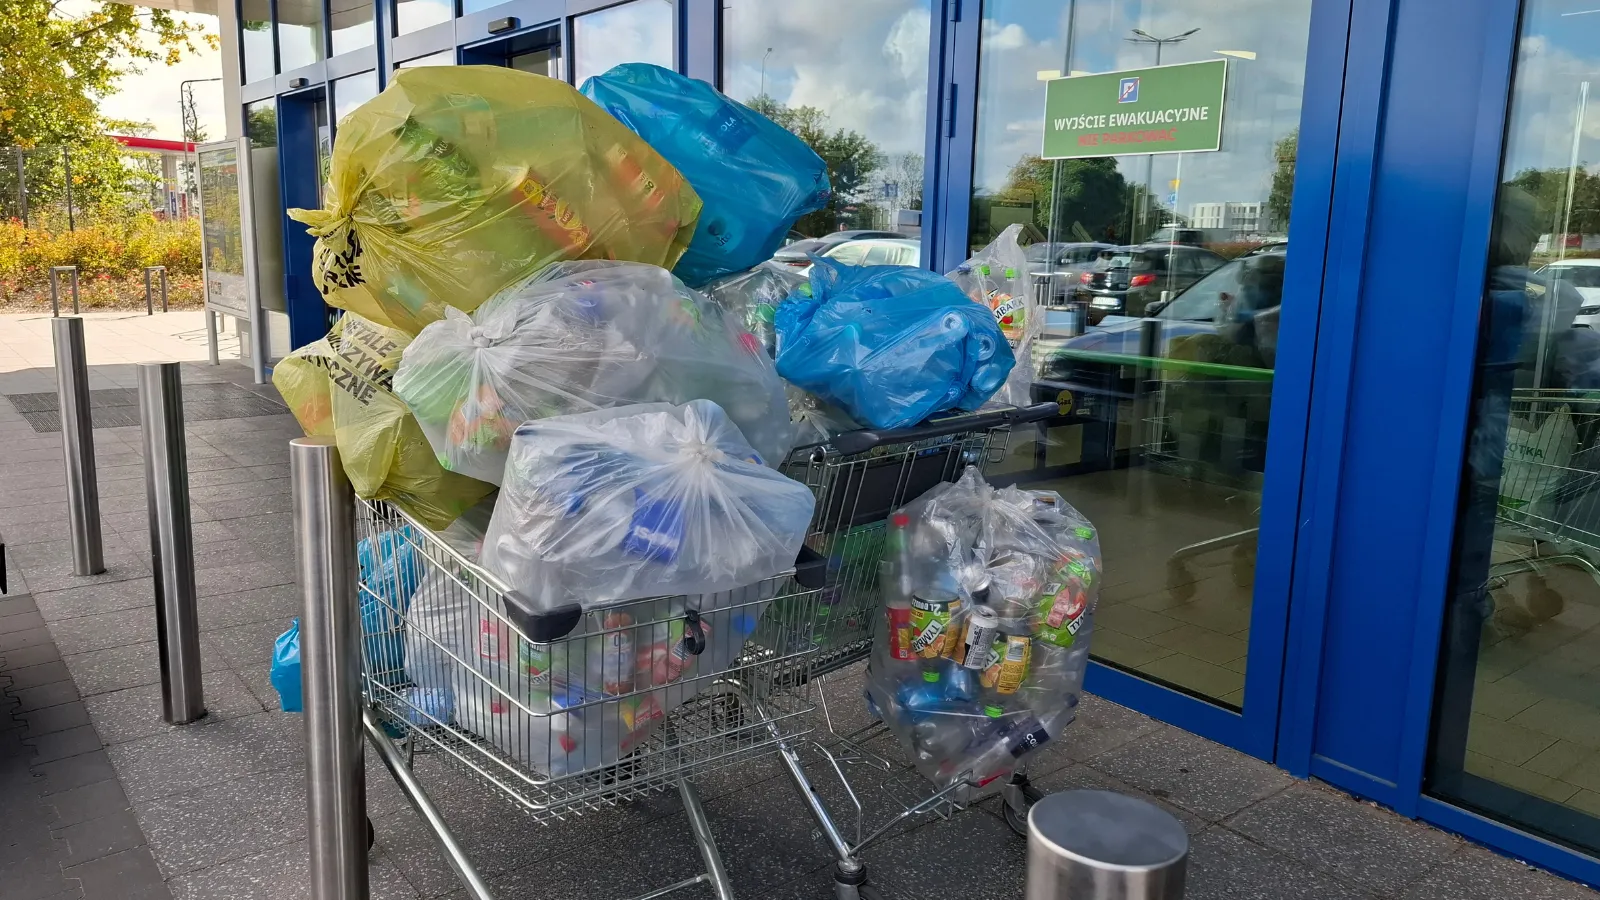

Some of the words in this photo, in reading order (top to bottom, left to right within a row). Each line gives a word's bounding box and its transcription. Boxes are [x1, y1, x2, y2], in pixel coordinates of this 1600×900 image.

[1054, 114, 1106, 131] WYJŚCIE
[1109, 106, 1209, 127] EWAKUACYJNE
[1078, 133, 1099, 147] NIE
[1102, 127, 1178, 145] PARKOWAĆ
